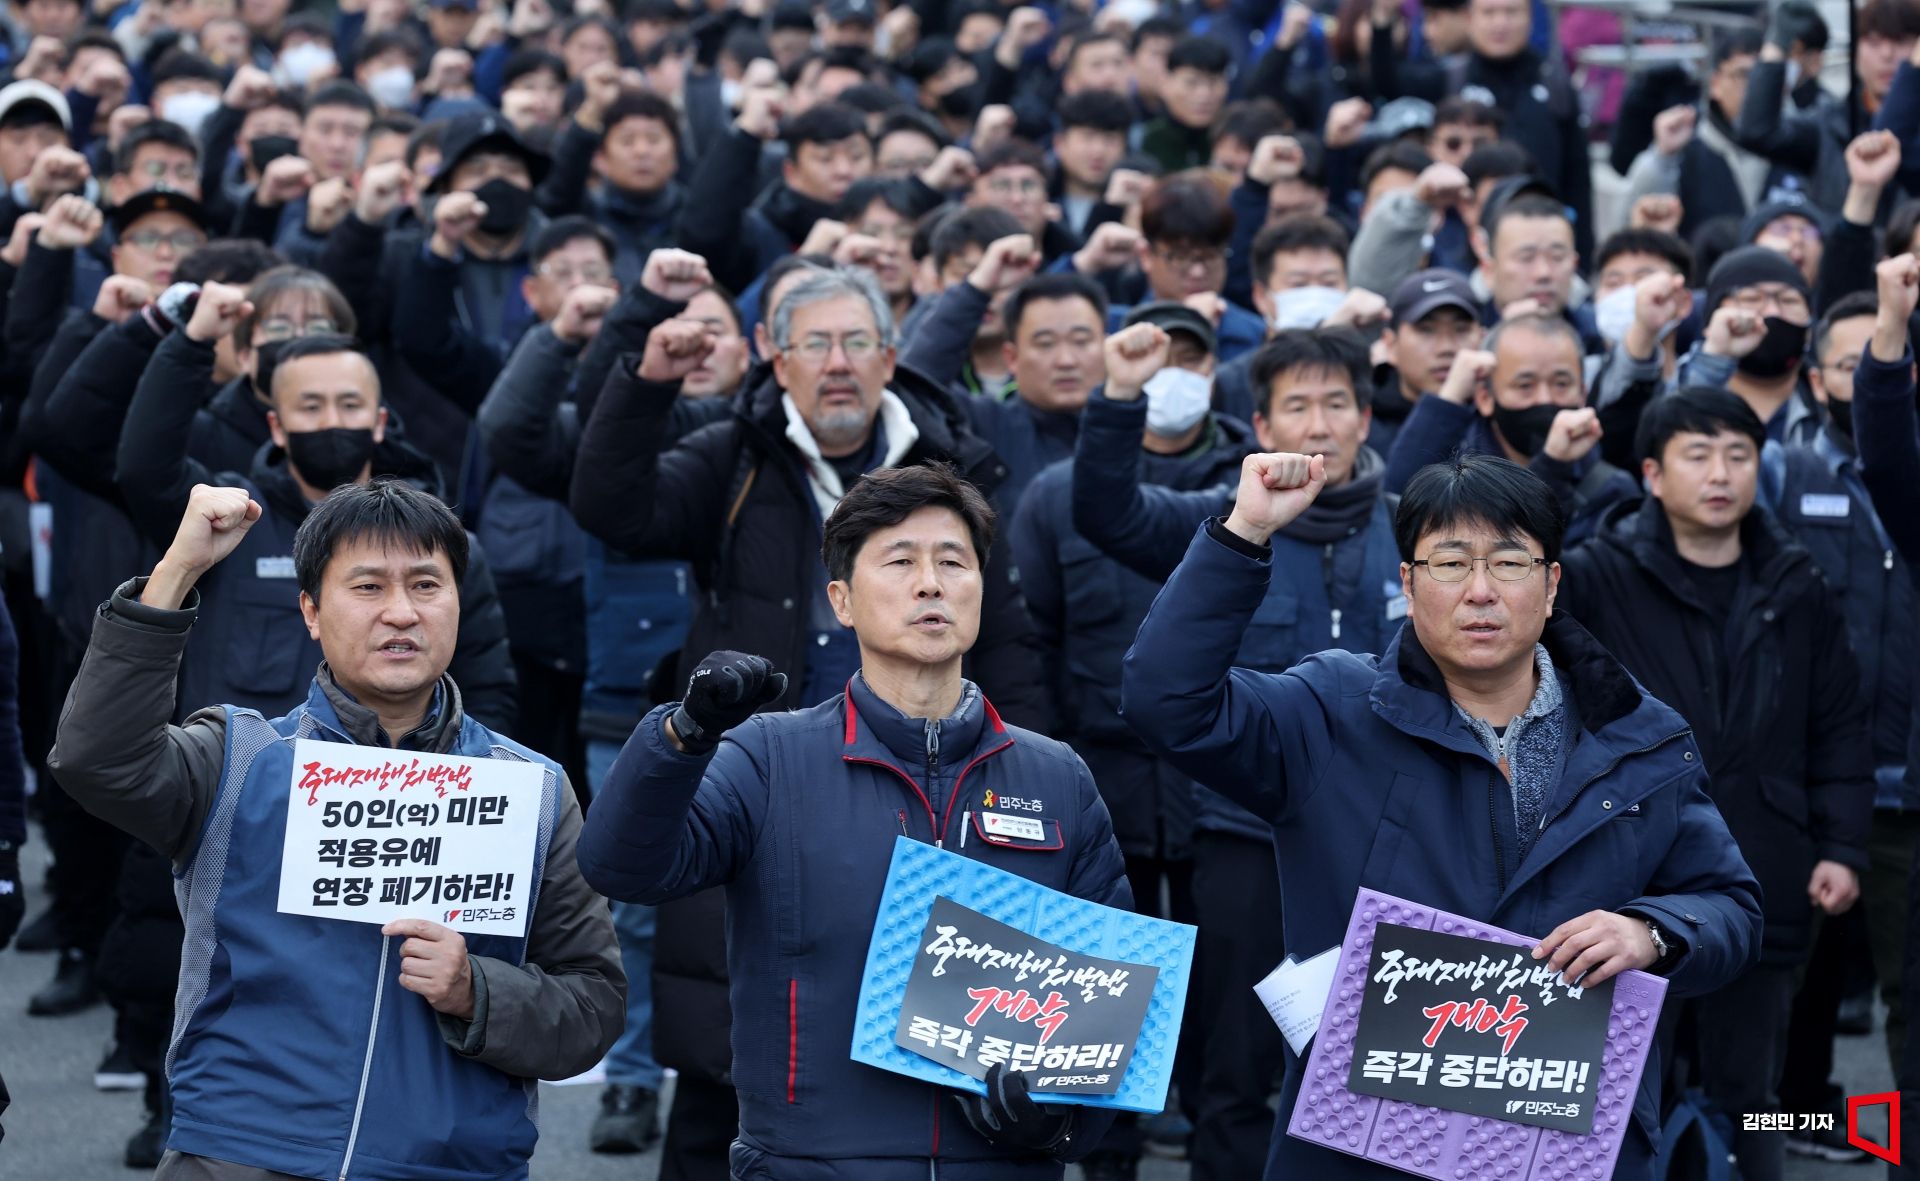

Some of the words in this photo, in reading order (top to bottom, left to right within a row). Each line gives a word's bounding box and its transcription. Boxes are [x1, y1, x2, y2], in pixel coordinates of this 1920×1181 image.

[298, 759, 472, 806] 중대재해처벌법
[321, 799, 439, 829] 50인(억)
[447, 796, 508, 825] 미만
[999, 796, 1043, 812] 민주노총
[317, 837, 441, 867] 적용유예
[312, 877, 373, 906] 연장
[379, 873, 514, 906] 폐기하라!
[462, 907, 516, 922] 민주노총
[925, 924, 1129, 1003] 중대재해처벌법
[964, 986, 1069, 1045] 개악
[1422, 995, 1529, 1057] 개악
[908, 1015, 973, 1057] 즉각
[977, 1035, 1124, 1072] 중단하라!
[1056, 1074, 1110, 1086] 민주노총
[1362, 1051, 1433, 1085] 즉각
[1439, 1053, 1590, 1094] 중단하라!
[1525, 1101, 1580, 1117] 민주노총
